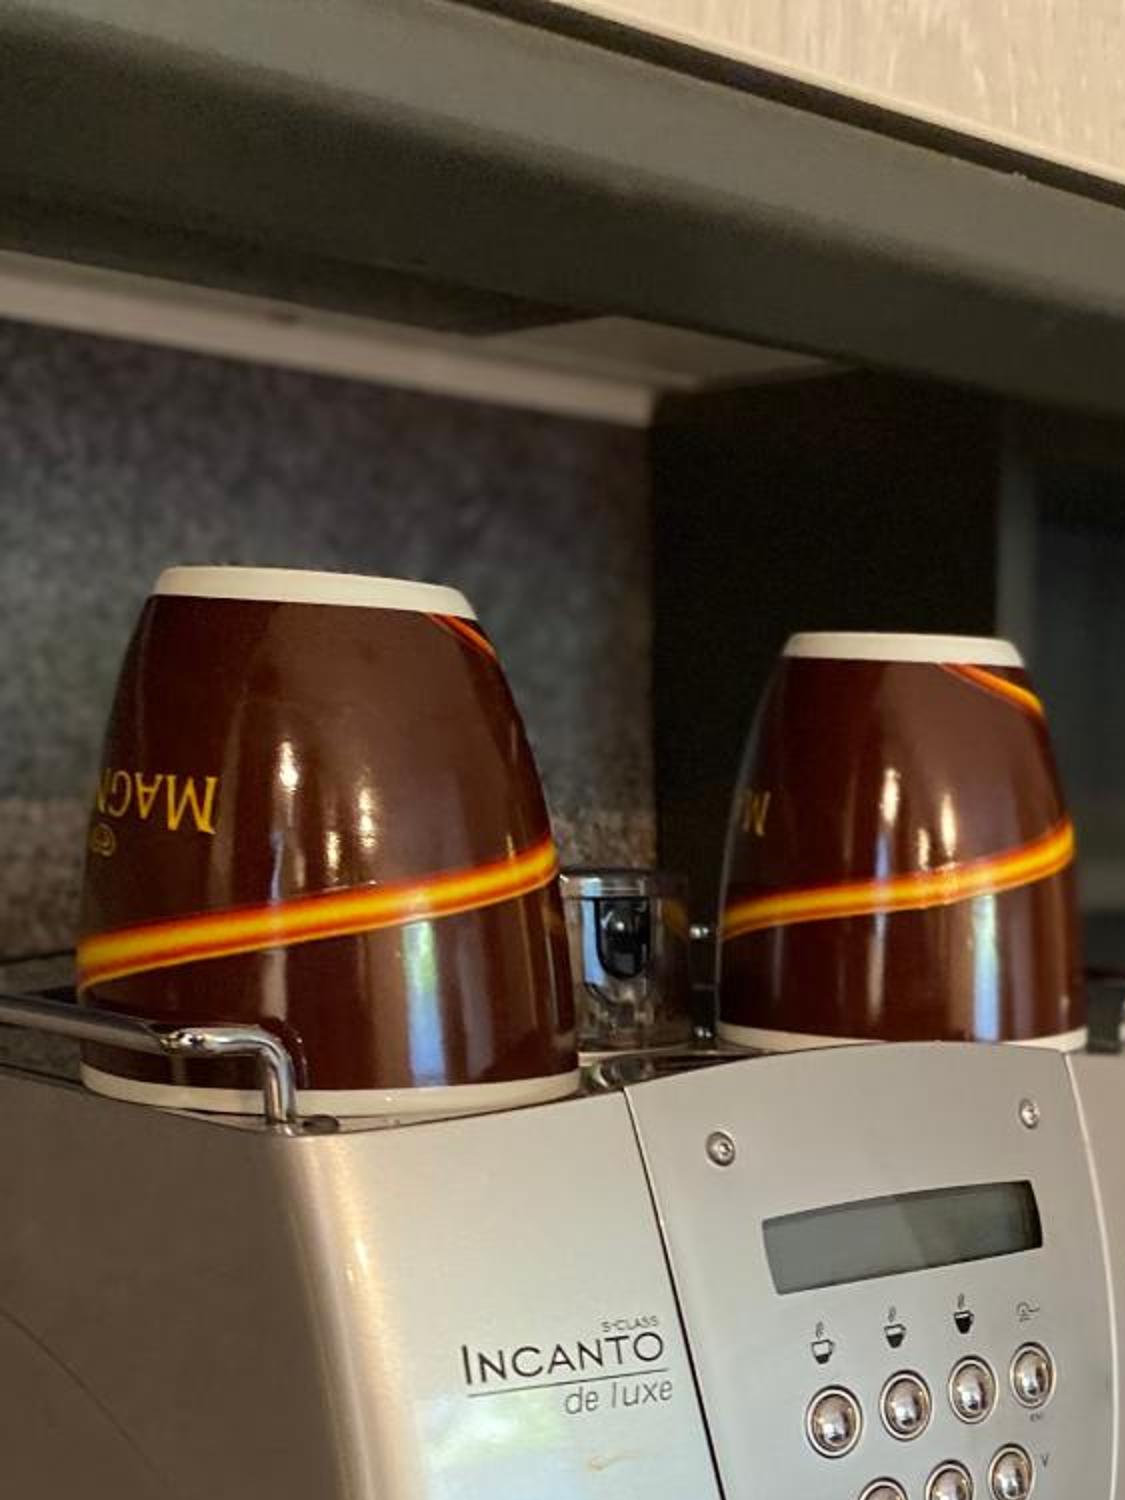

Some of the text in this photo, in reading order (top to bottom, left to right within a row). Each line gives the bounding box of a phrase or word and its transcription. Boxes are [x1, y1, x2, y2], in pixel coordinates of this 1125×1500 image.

[601, 1315, 660, 1333] S-CLASS
[461, 1331, 664, 1386] INCANTO
[564, 1379, 673, 1415] de luxe
